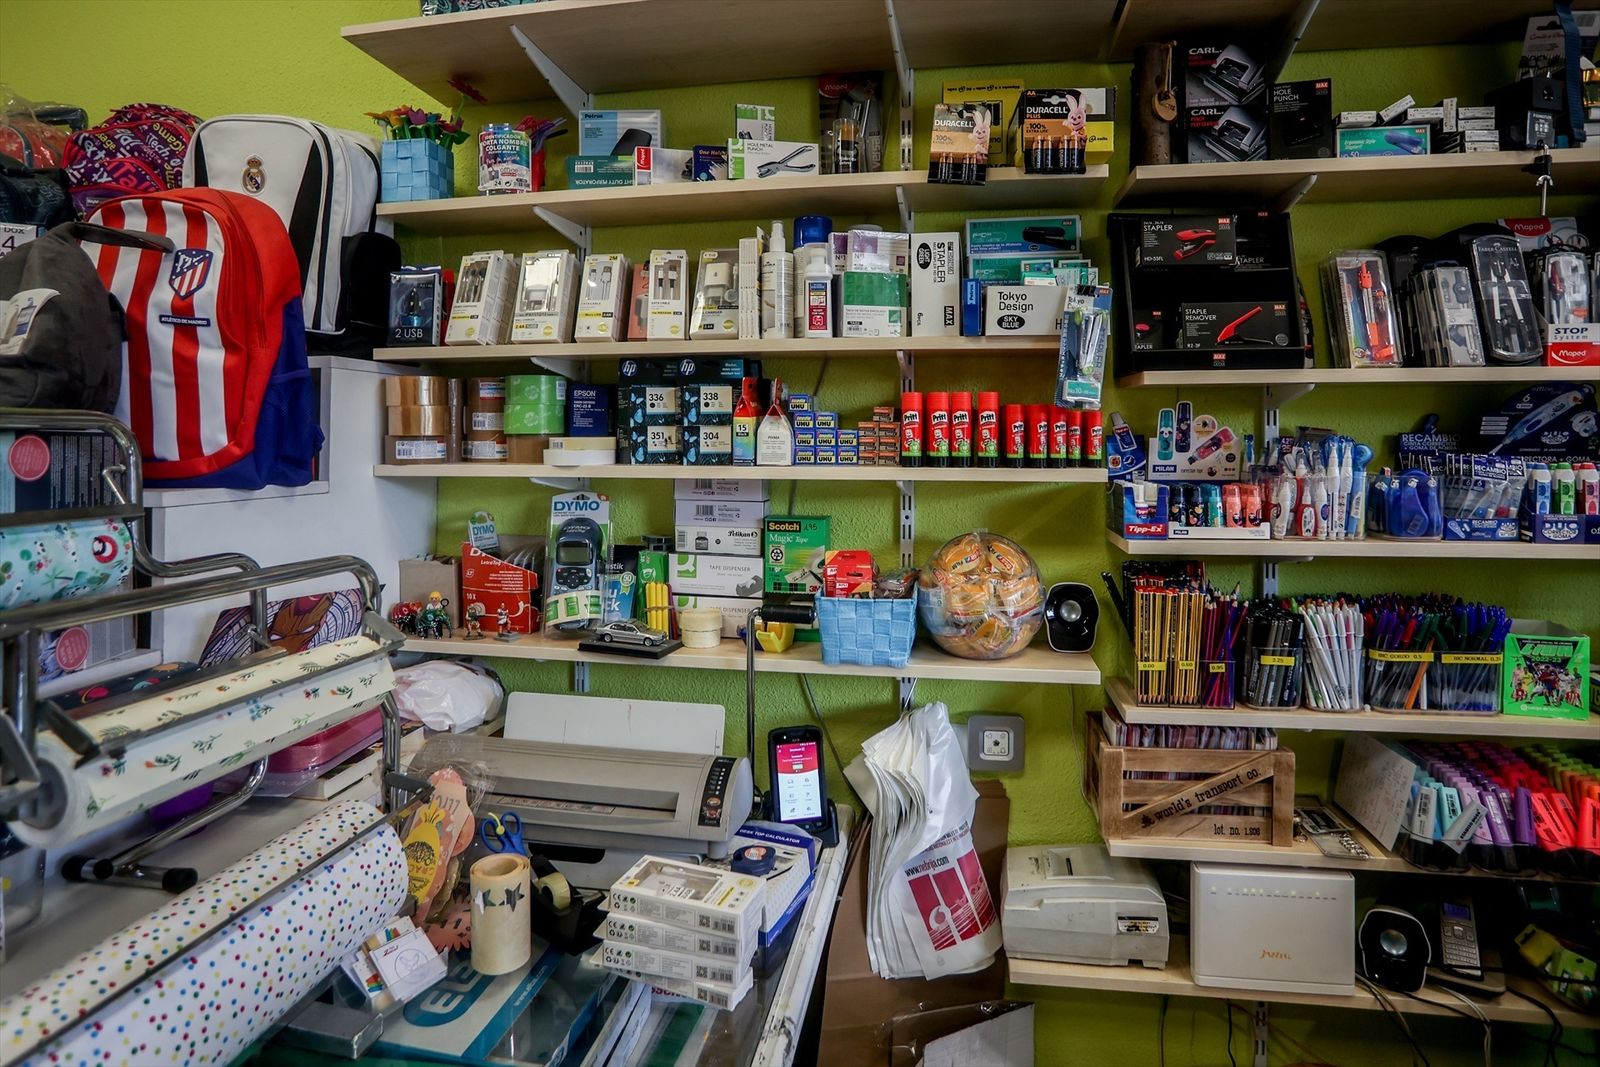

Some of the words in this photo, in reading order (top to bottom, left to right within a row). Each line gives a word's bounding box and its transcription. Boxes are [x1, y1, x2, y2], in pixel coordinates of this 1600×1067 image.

[937, 242, 945, 283] STAPLER
[998, 292, 1027, 302] Tokyo
[998, 302, 1034, 313] Design
[946, 306, 954, 325] MAX
[395, 328, 402, 338] 2
[404, 329, 424, 338] USB
[648, 394, 664, 402] 336
[703, 393, 719, 401] 338
[904, 412, 918, 421] Pritt
[933, 413, 947, 421] Pritt
[954, 413, 967, 421] Pritt
[650, 432, 664, 440] 351
[703, 432, 719, 440] 304
[554, 500, 600, 511] DYMO
[473, 524, 494, 535] DYMO
[1128, 526, 1163, 534] Tipp-Ex
[769, 534, 793, 544] Magic
[1154, 798, 1192, 822] world's
[1195, 774, 1244, 803] transport
[1246, 769, 1261, 780] co.
[1230, 827, 1240, 836] no.
[765, 833, 800, 844] CALCULATOR
